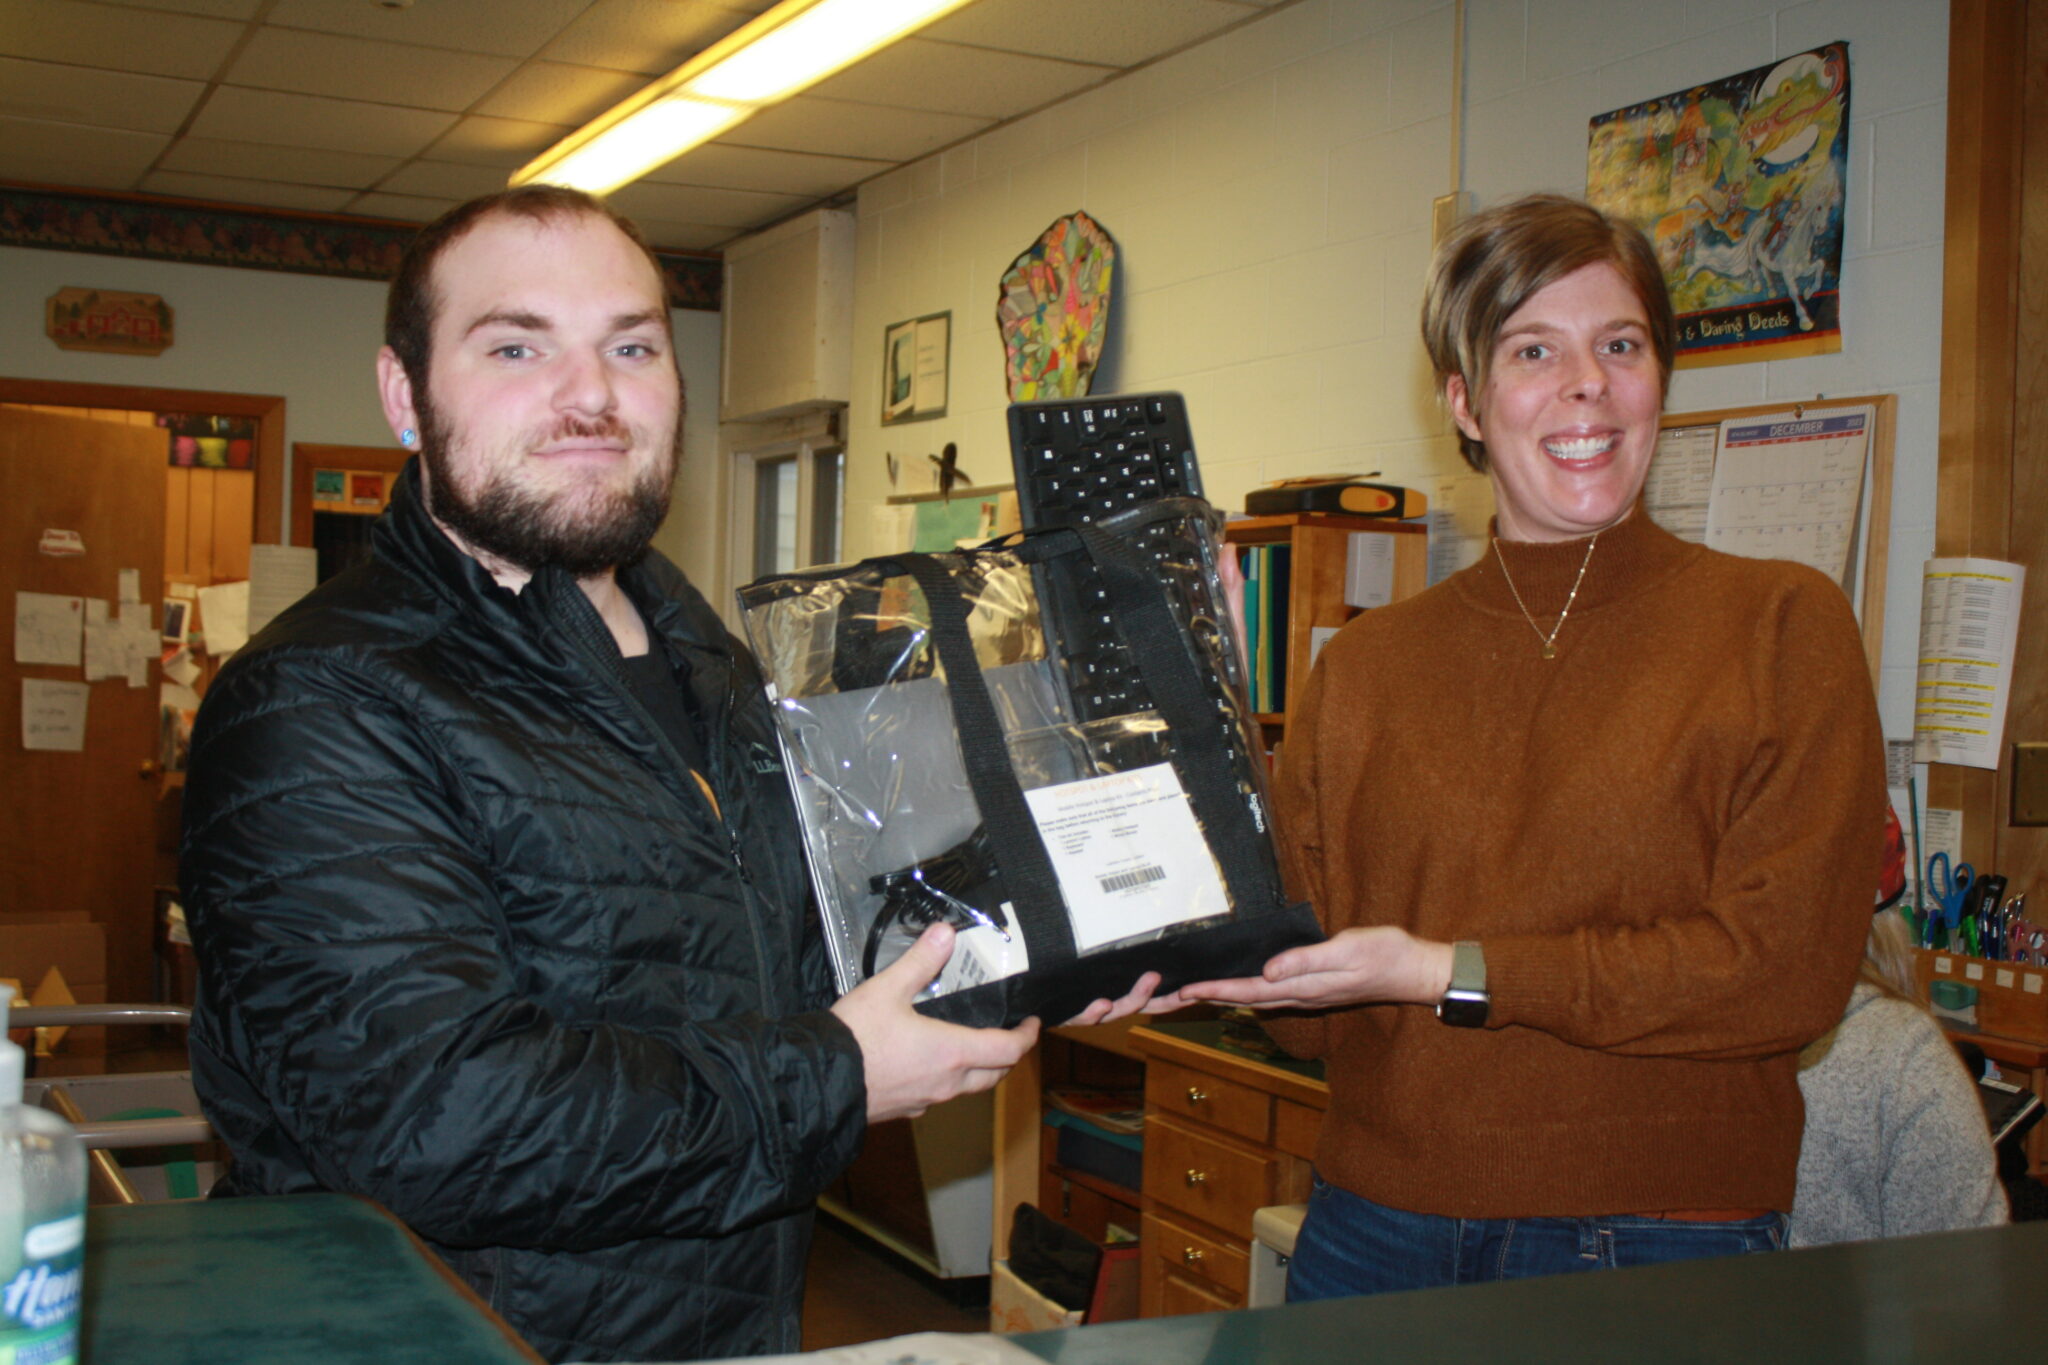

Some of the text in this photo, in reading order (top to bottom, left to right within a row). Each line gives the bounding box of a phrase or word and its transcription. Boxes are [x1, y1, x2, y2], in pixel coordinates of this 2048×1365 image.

[1686, 326, 1695, 341] &
[1701, 318, 1745, 341] Daring
[1749, 311, 1790, 331] Deeds
[1769, 421, 1824, 437] DECEMBER
[1249, 793, 1265, 833] logitech
